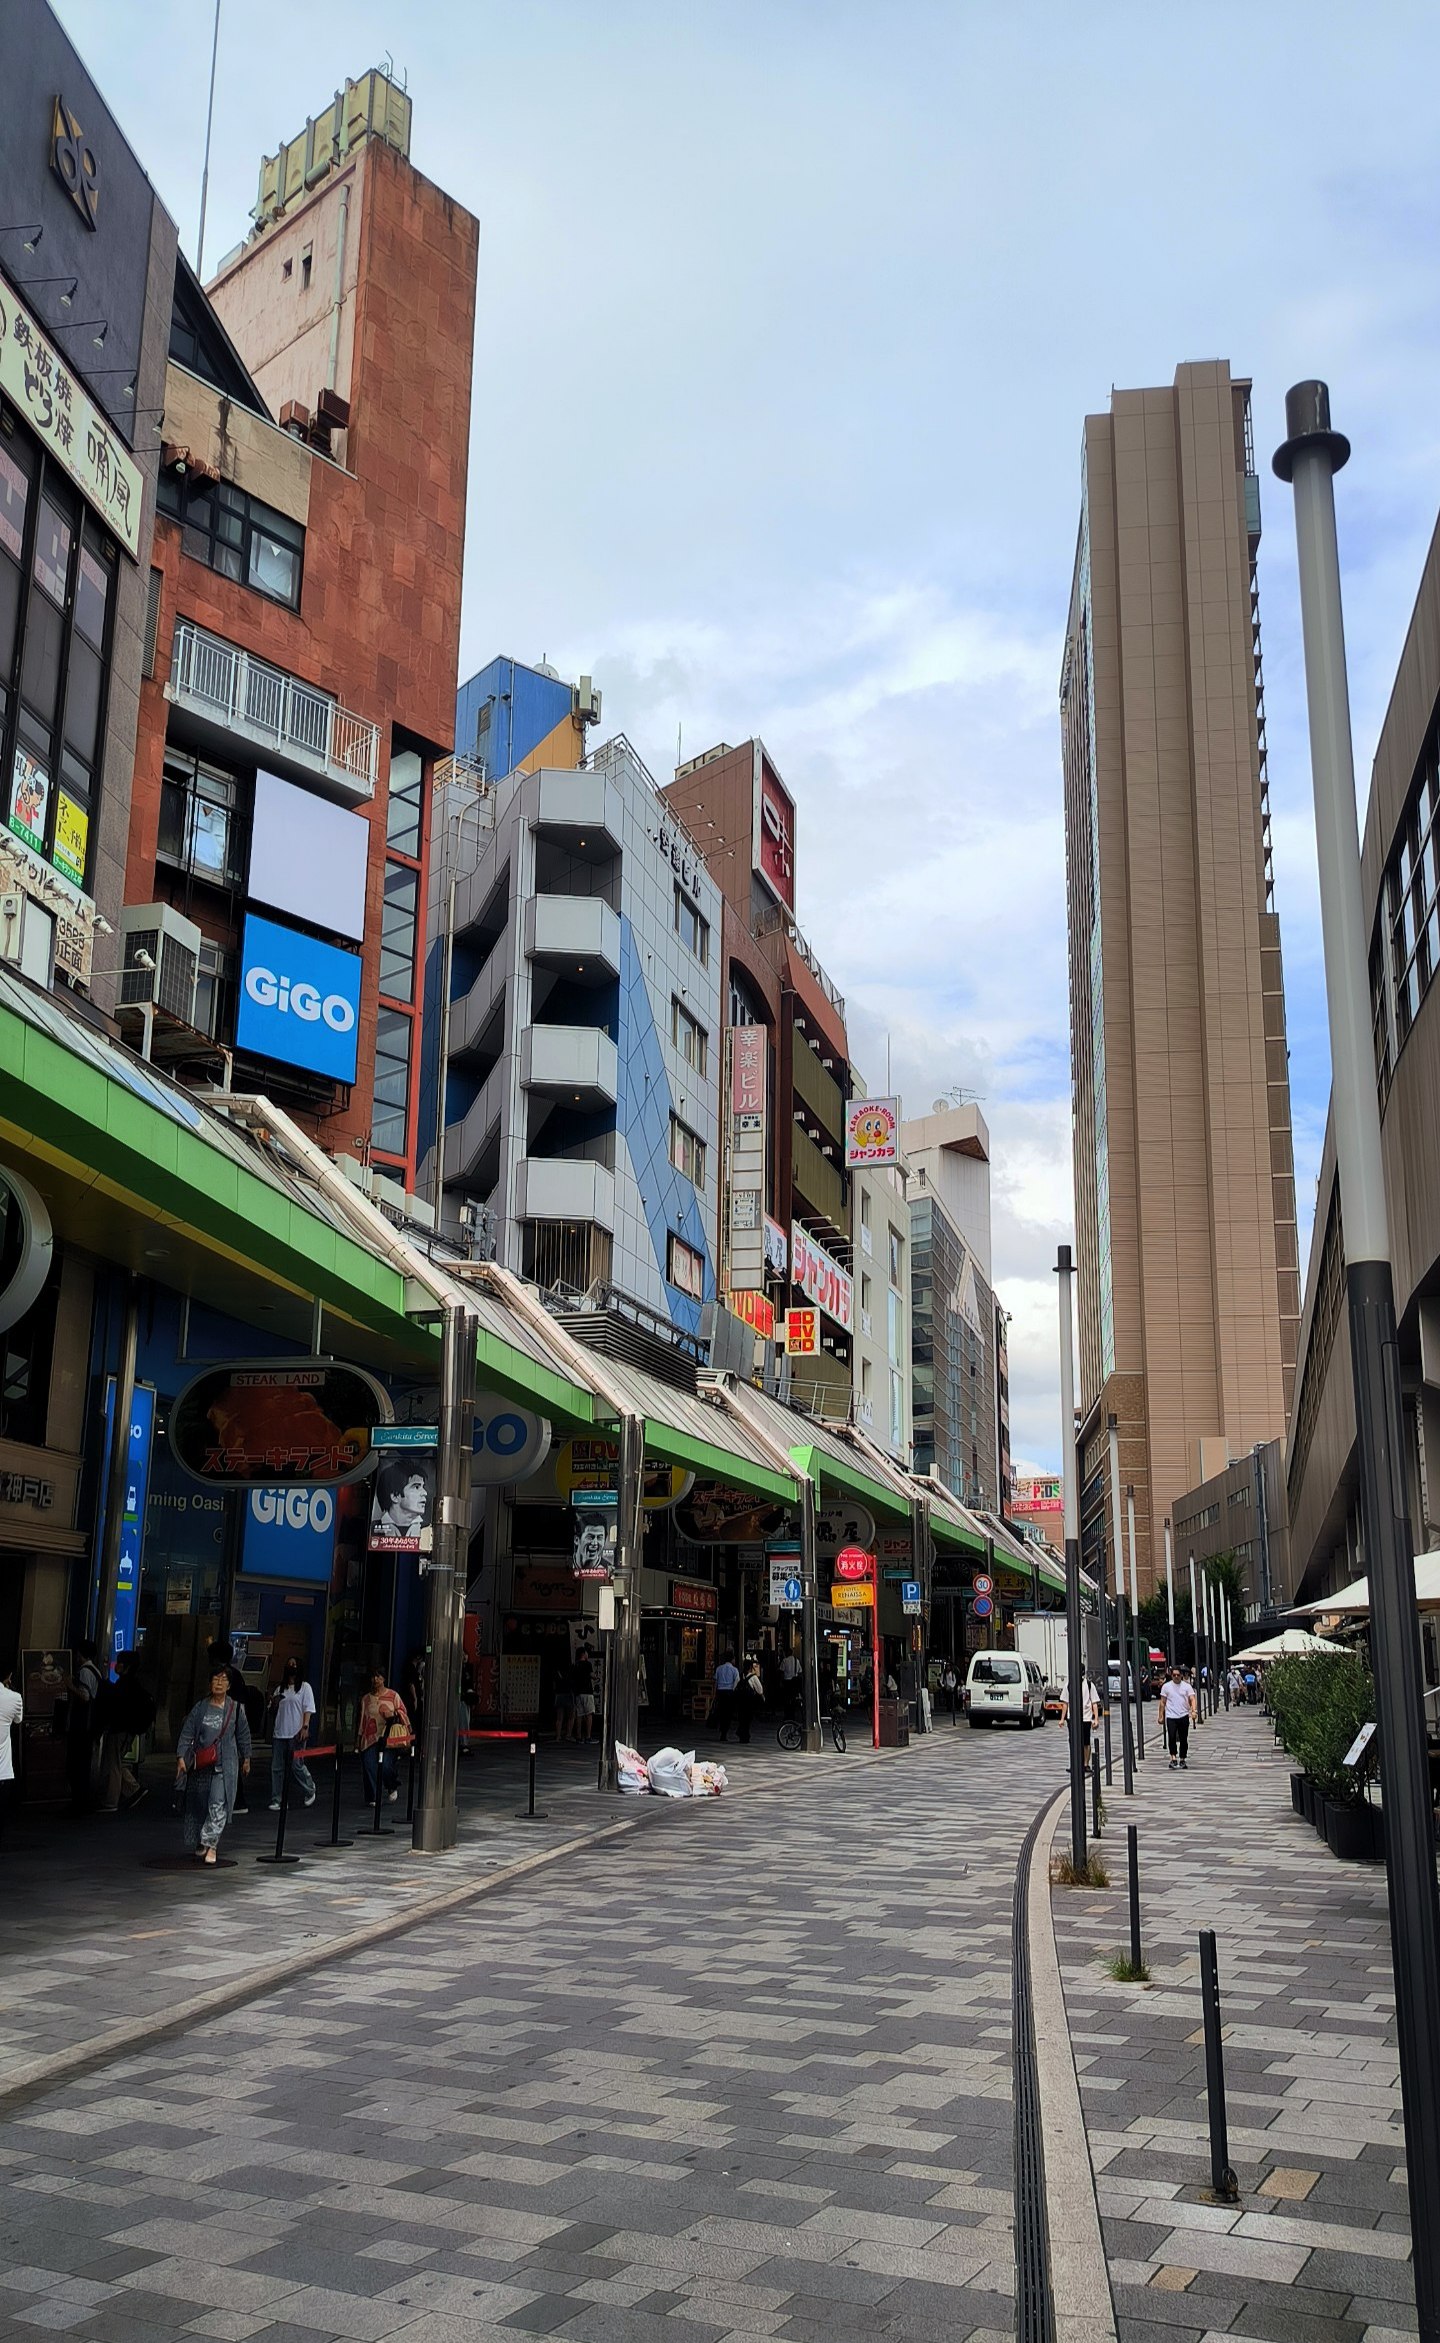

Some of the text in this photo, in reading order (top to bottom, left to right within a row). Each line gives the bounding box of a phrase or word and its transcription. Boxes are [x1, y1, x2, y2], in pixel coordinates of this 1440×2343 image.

[14, 312, 73, 413] 鉄板焼
[246, 966, 355, 1033] GiGO
[739, 1029, 759, 1109] 幸楽ビル
[849, 1146, 896, 1160] ジャンカラ
[794, 1233, 850, 1325] ジャンカラ
[802, 1311, 815, 1352] DVD
[236, 1373, 321, 1386] STEAK LAND
[200, 1445, 354, 1473] ステーキランド
[5, 1471, 55, 1508] 神戸店
[252, 1488, 333, 1533] GiGO
[840, 1559, 864, 1571] 消火栓
[906, 1583, 917, 1599] P
[977, 1580, 989, 1589] 30
